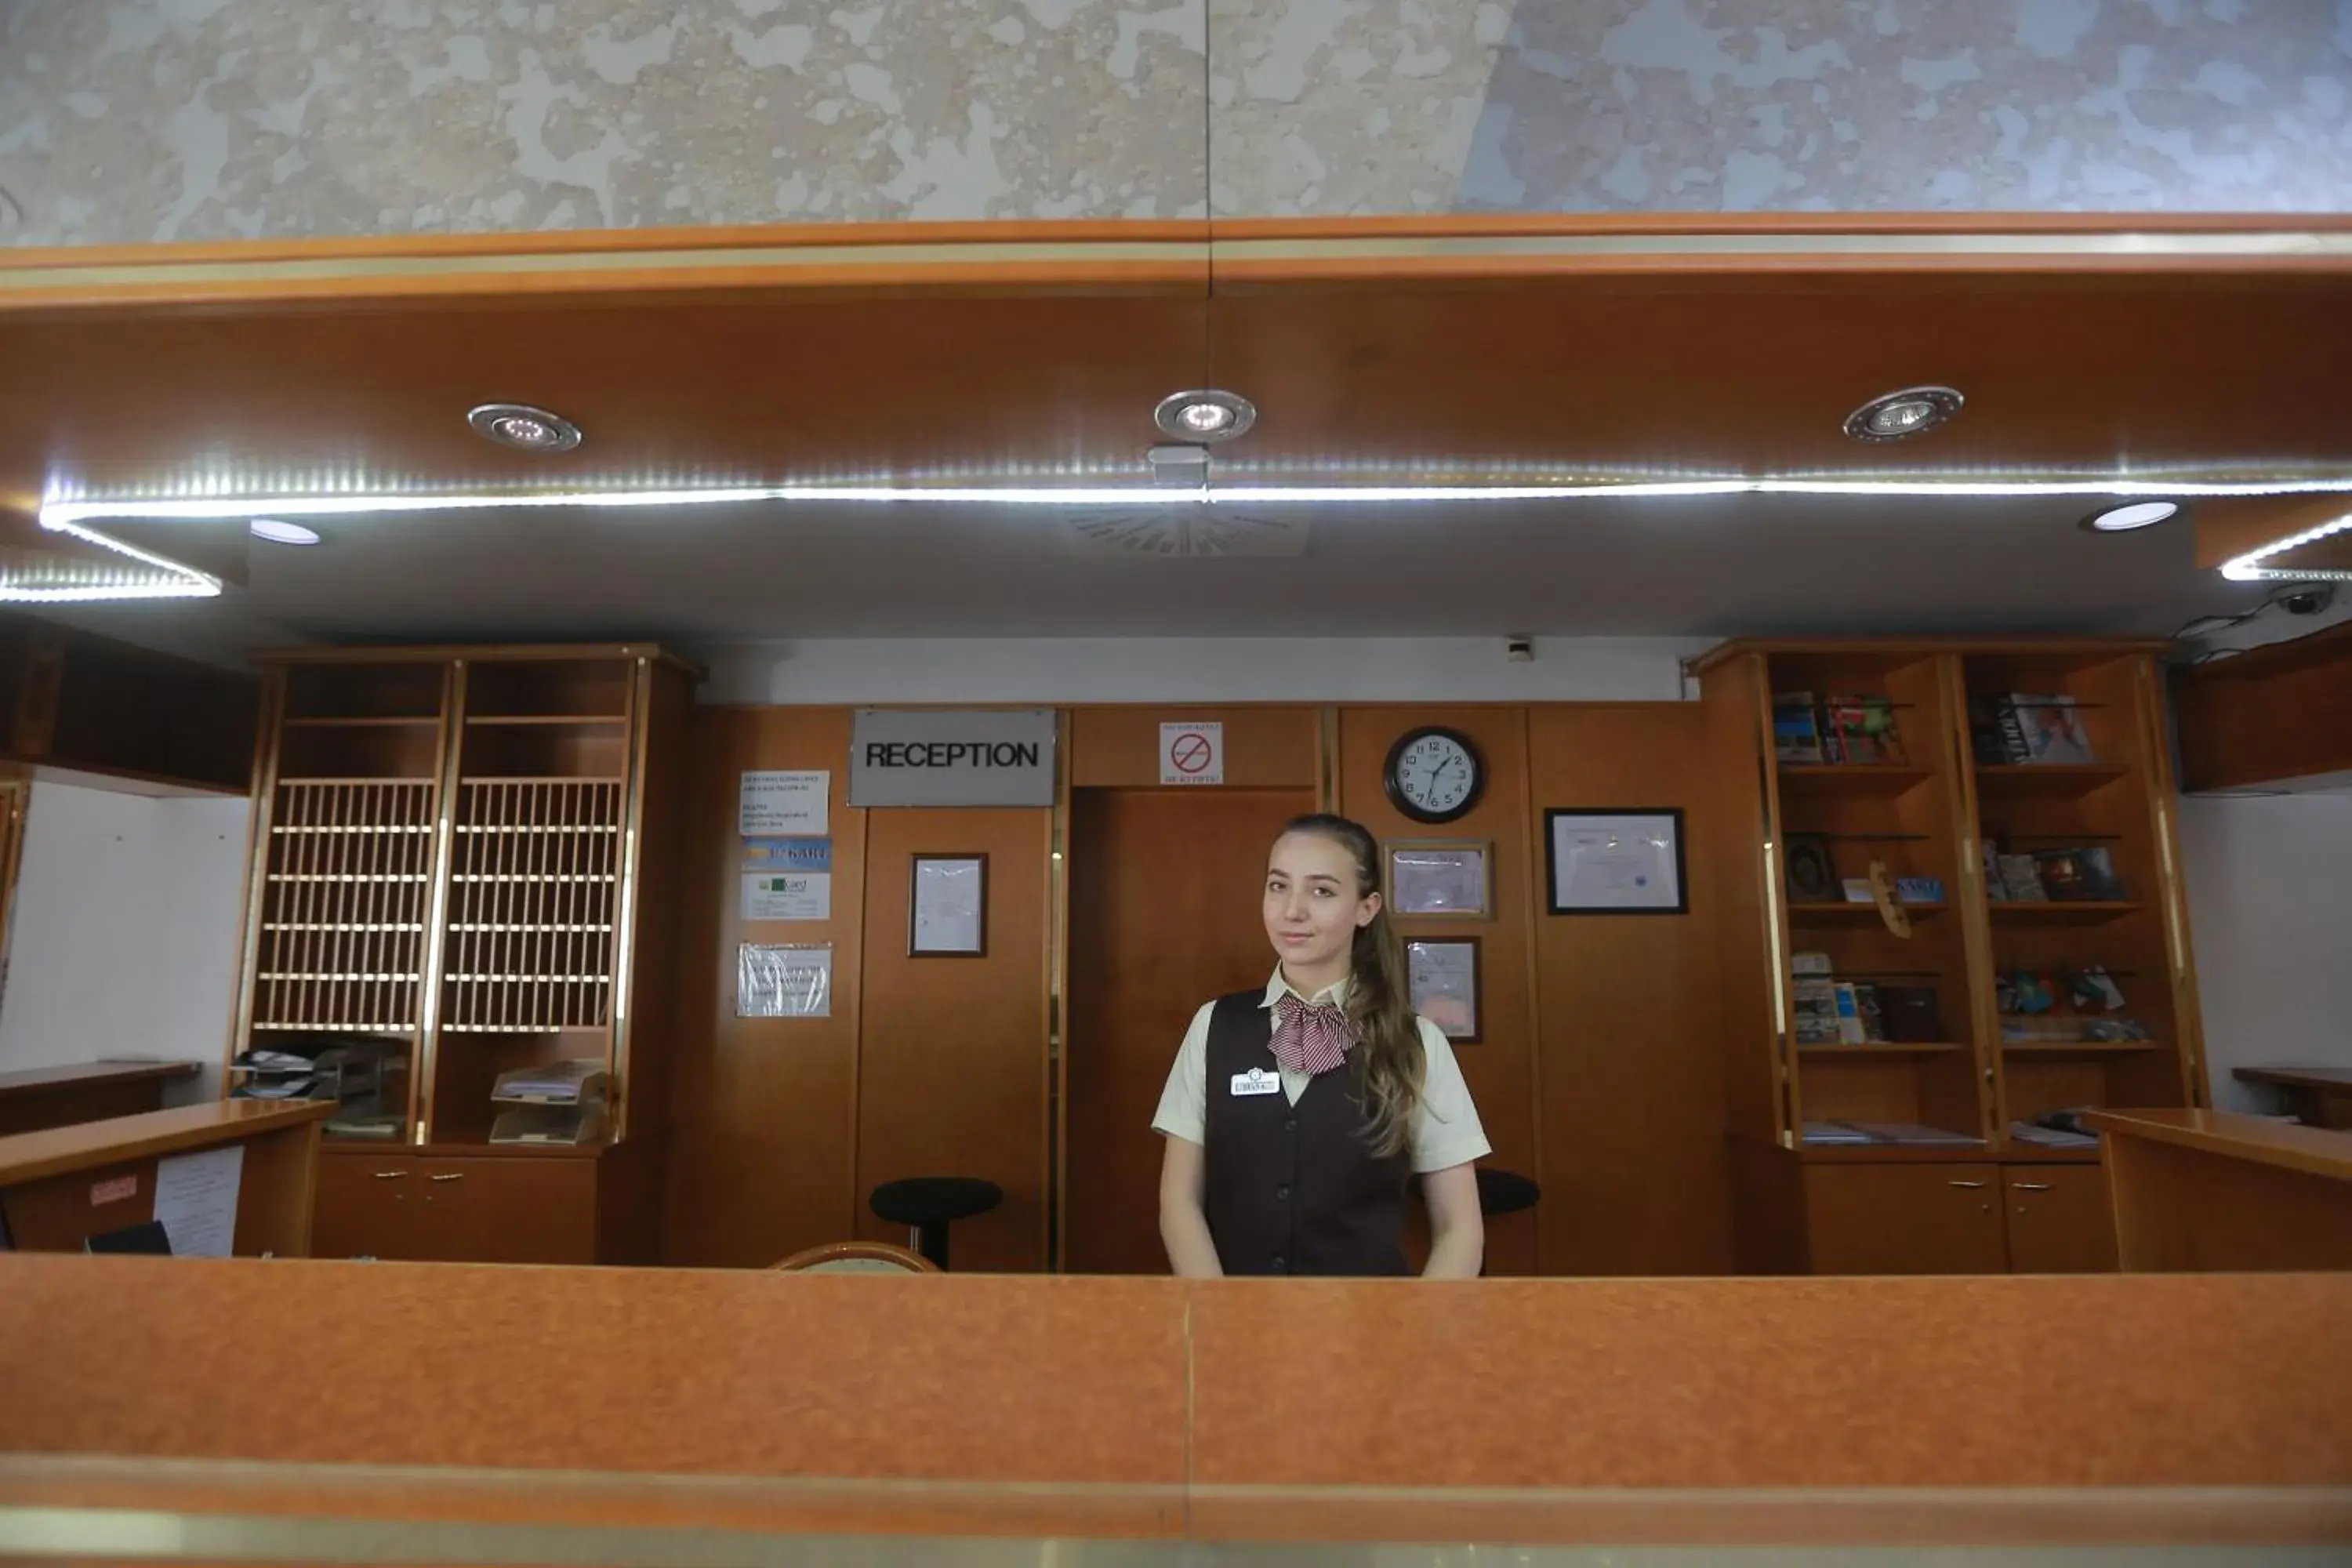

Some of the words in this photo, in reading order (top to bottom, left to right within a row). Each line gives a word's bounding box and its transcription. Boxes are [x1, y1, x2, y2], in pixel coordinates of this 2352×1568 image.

[1429, 742, 1439, 752] 12
[866, 742, 1038, 768] RECEPTION
[1406, 755, 1417, 765] 10
[1454, 755, 1462, 766] 2
[1402, 769, 1410, 779] 9
[1459, 770, 1466, 780] 3
[1406, 782, 1414, 793] 8
[1454, 785, 1462, 793] 4
[1416, 793, 1425, 803] 7
[1431, 797, 1439, 807] 6
[1444, 793, 1453, 804] 5
